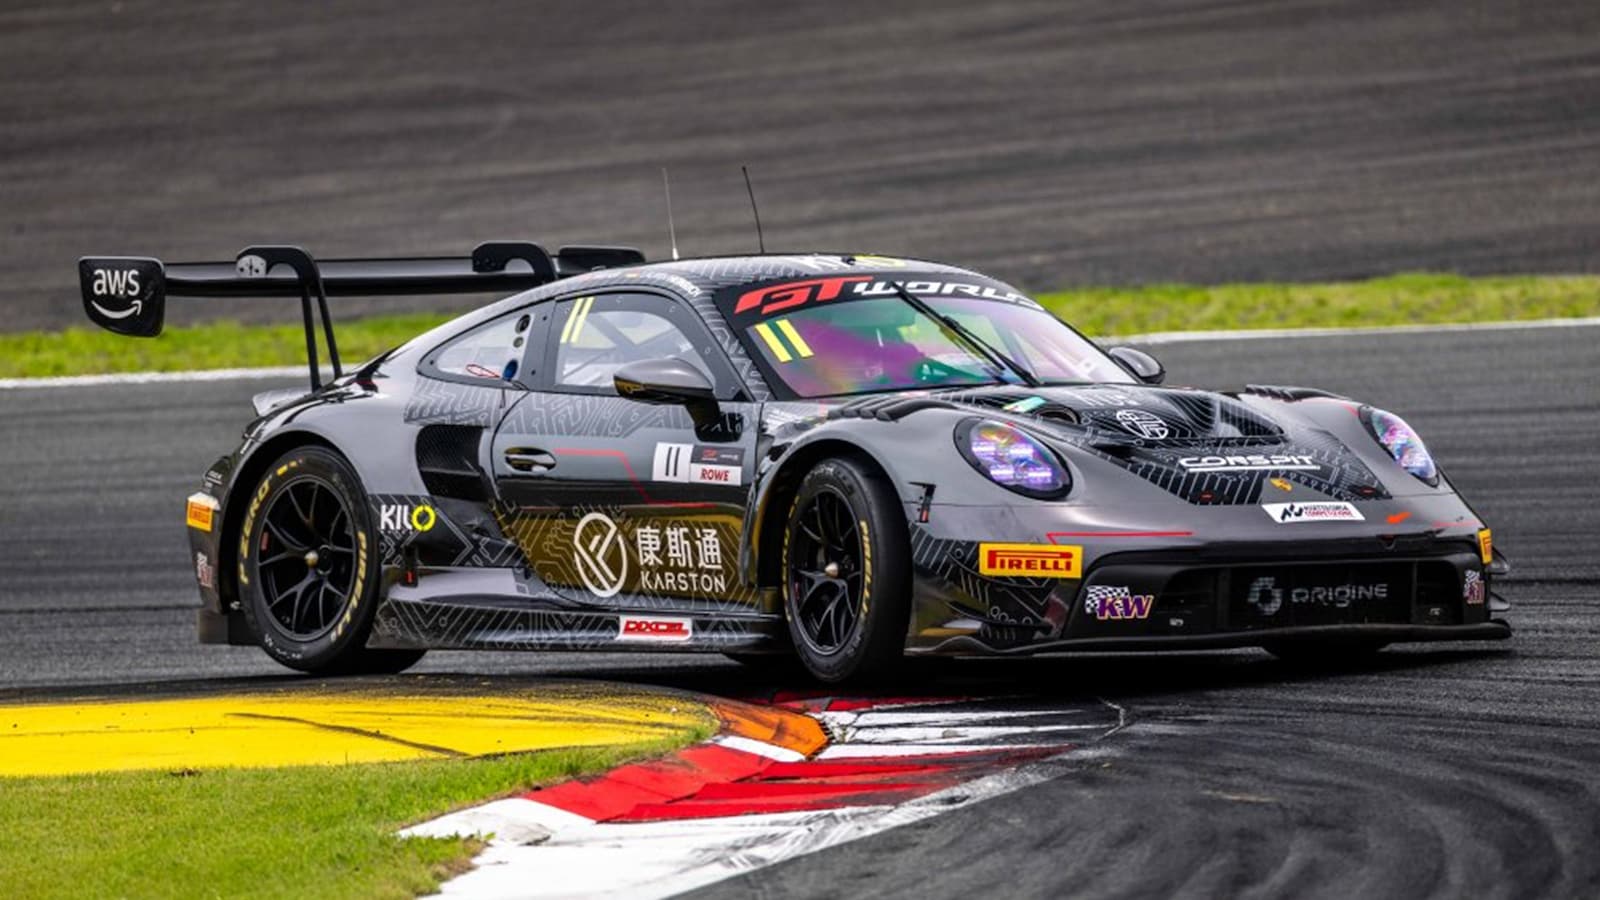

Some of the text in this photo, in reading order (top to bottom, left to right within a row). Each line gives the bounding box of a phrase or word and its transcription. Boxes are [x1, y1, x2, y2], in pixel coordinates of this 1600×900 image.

[93, 269, 141, 296] aws
[734, 276, 873, 315] GT
[560, 296, 595, 344] 11
[755, 319, 814, 362] 11
[665, 446, 681, 477] 11
[700, 468, 730, 482] ROWE
[380, 504, 436, 532] KILO
[637, 526, 723, 569] 康斯通
[987, 549, 1073, 571] PIRELLI
[640, 570, 726, 593] KARSTON
[1097, 595, 1154, 620] KW
